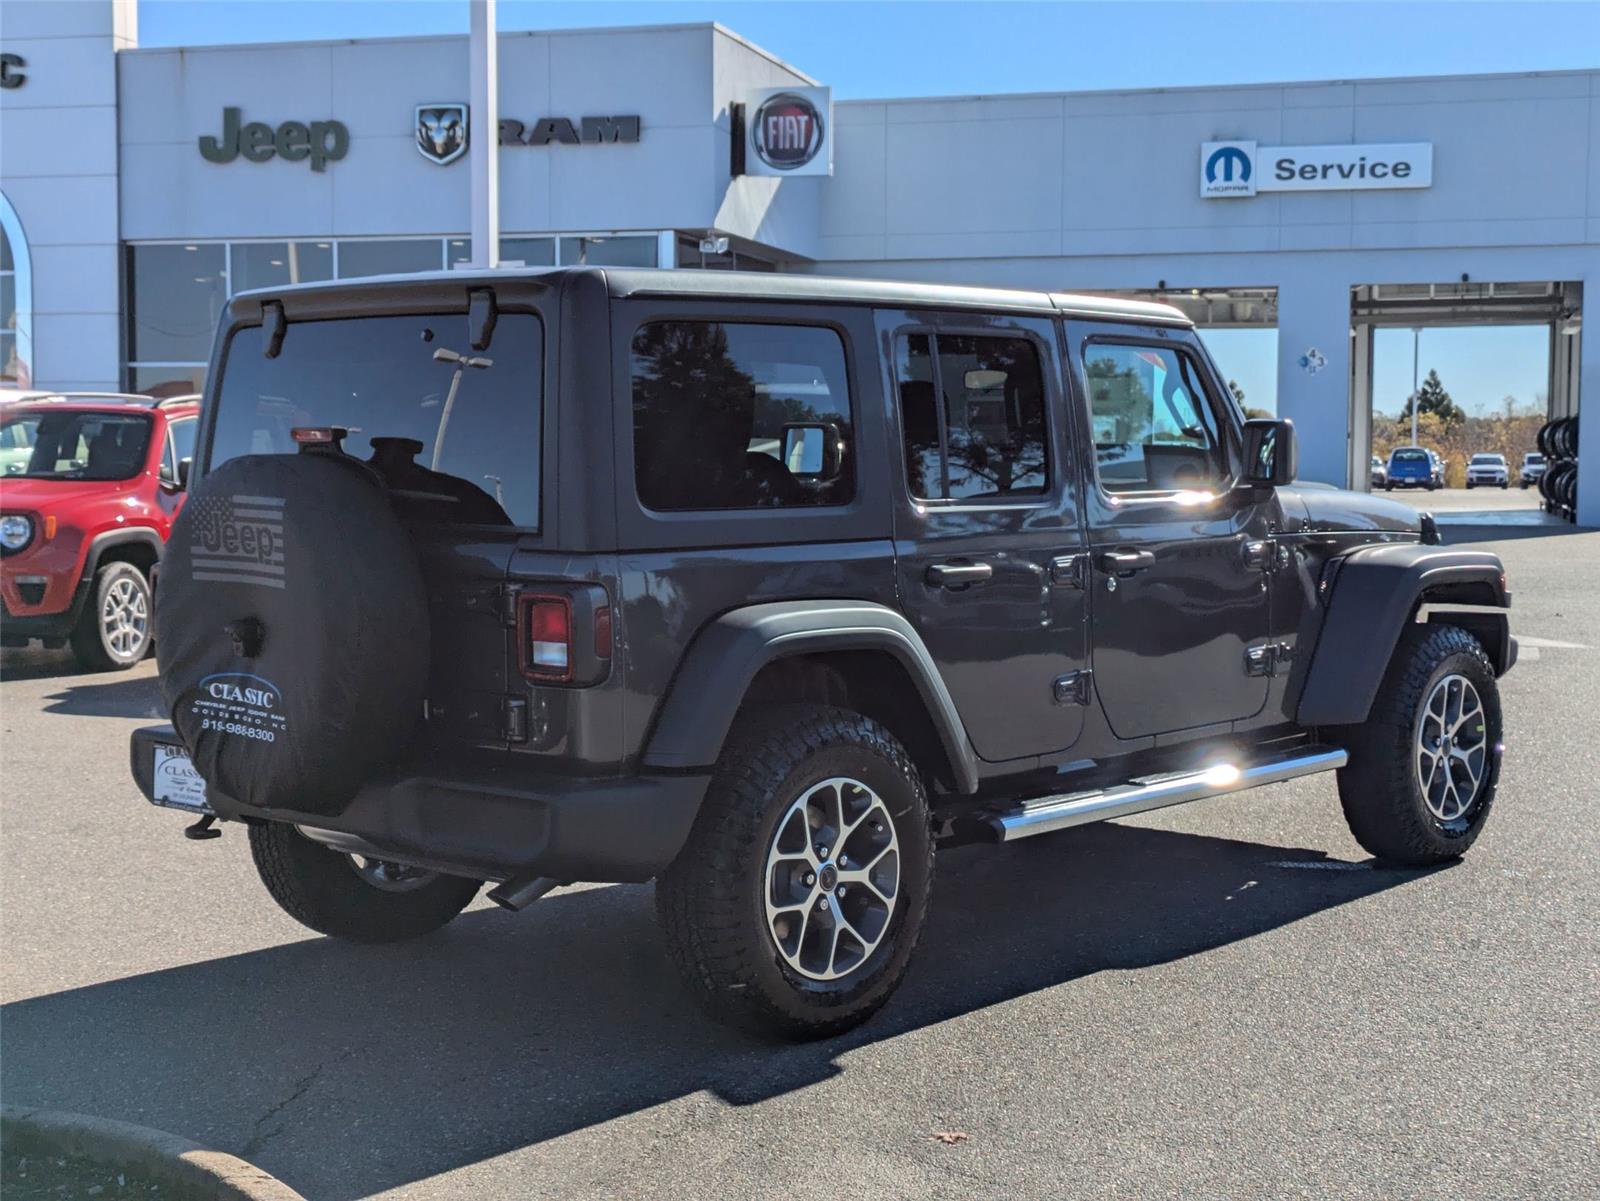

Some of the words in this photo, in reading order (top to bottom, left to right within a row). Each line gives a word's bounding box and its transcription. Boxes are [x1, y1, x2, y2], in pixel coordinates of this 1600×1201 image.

[198, 106, 350, 172] Jeep
[498, 115, 640, 146] RAM
[767, 115, 809, 150] FIAT
[1275, 157, 1412, 181] Service
[200, 511, 274, 565] Jeep
[209, 682, 274, 709] CLASSIC
